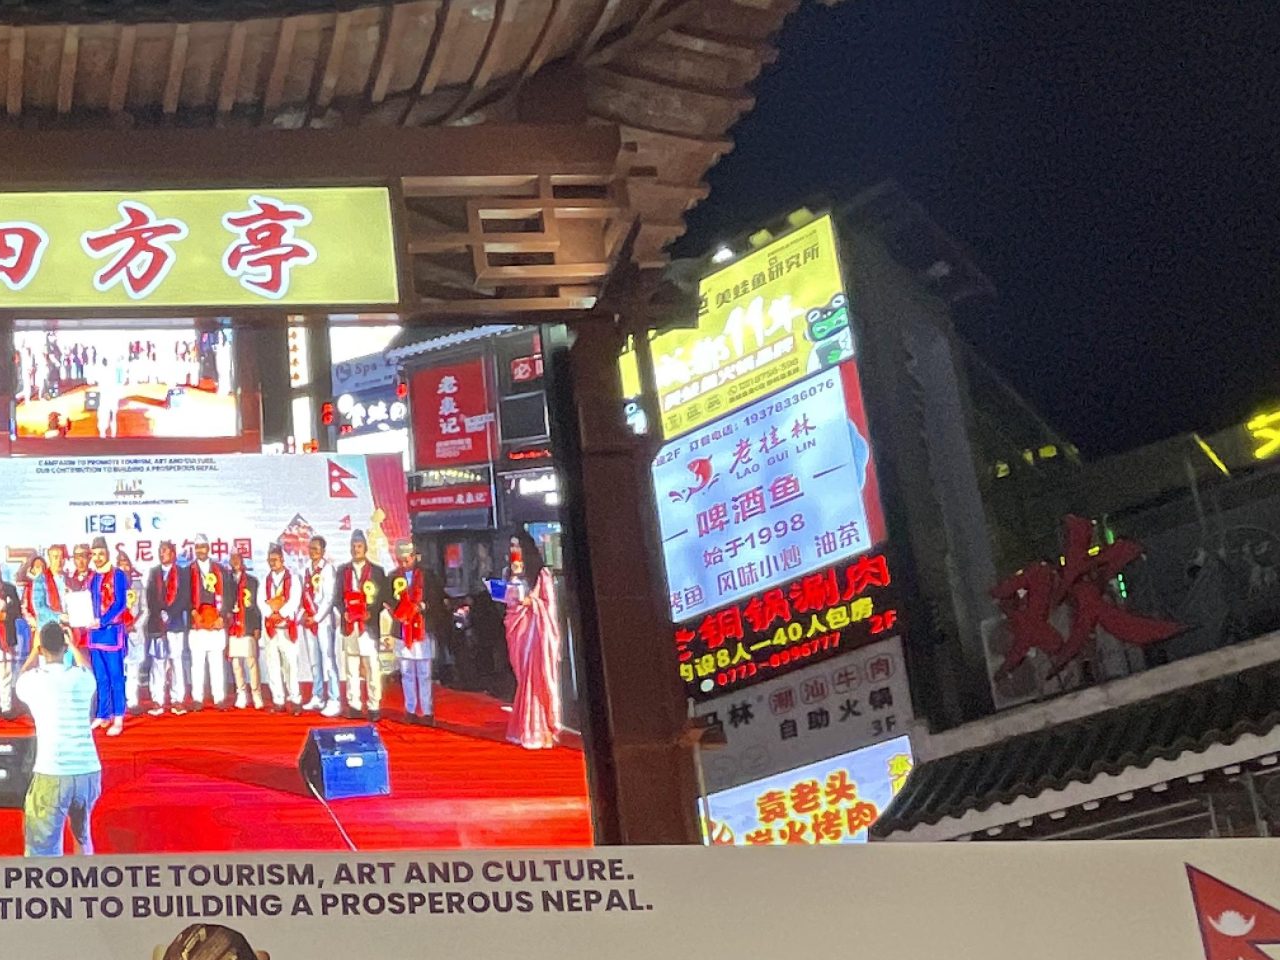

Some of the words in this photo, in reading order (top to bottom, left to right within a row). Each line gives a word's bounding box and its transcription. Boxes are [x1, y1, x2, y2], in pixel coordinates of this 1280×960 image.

[728, 413, 817, 475] 老桂林
[735, 463, 761, 480] LAO
[795, 437, 817, 454] LIN
[696, 473, 804, 538] 啤酒鱼
[703, 513, 806, 569] 始于1998
[717, 544, 802, 596] 风味小炒
[773, 658, 891, 713] 潮汕牛肉
[757, 768, 856, 824] 袁老头
[5, 865, 161, 889] PROMOTE
[167, 863, 325, 889] TOURISM,
[333, 862, 396, 884] ART
[404, 861, 475, 884] AND
[482, 859, 634, 883] CULTURE.
[80, 896, 123, 919] TO
[133, 893, 283, 918] BUILDING
[291, 894, 314, 916] A
[321, 891, 534, 915] PROSPEROUS
[543, 889, 654, 912] NEPAL.
